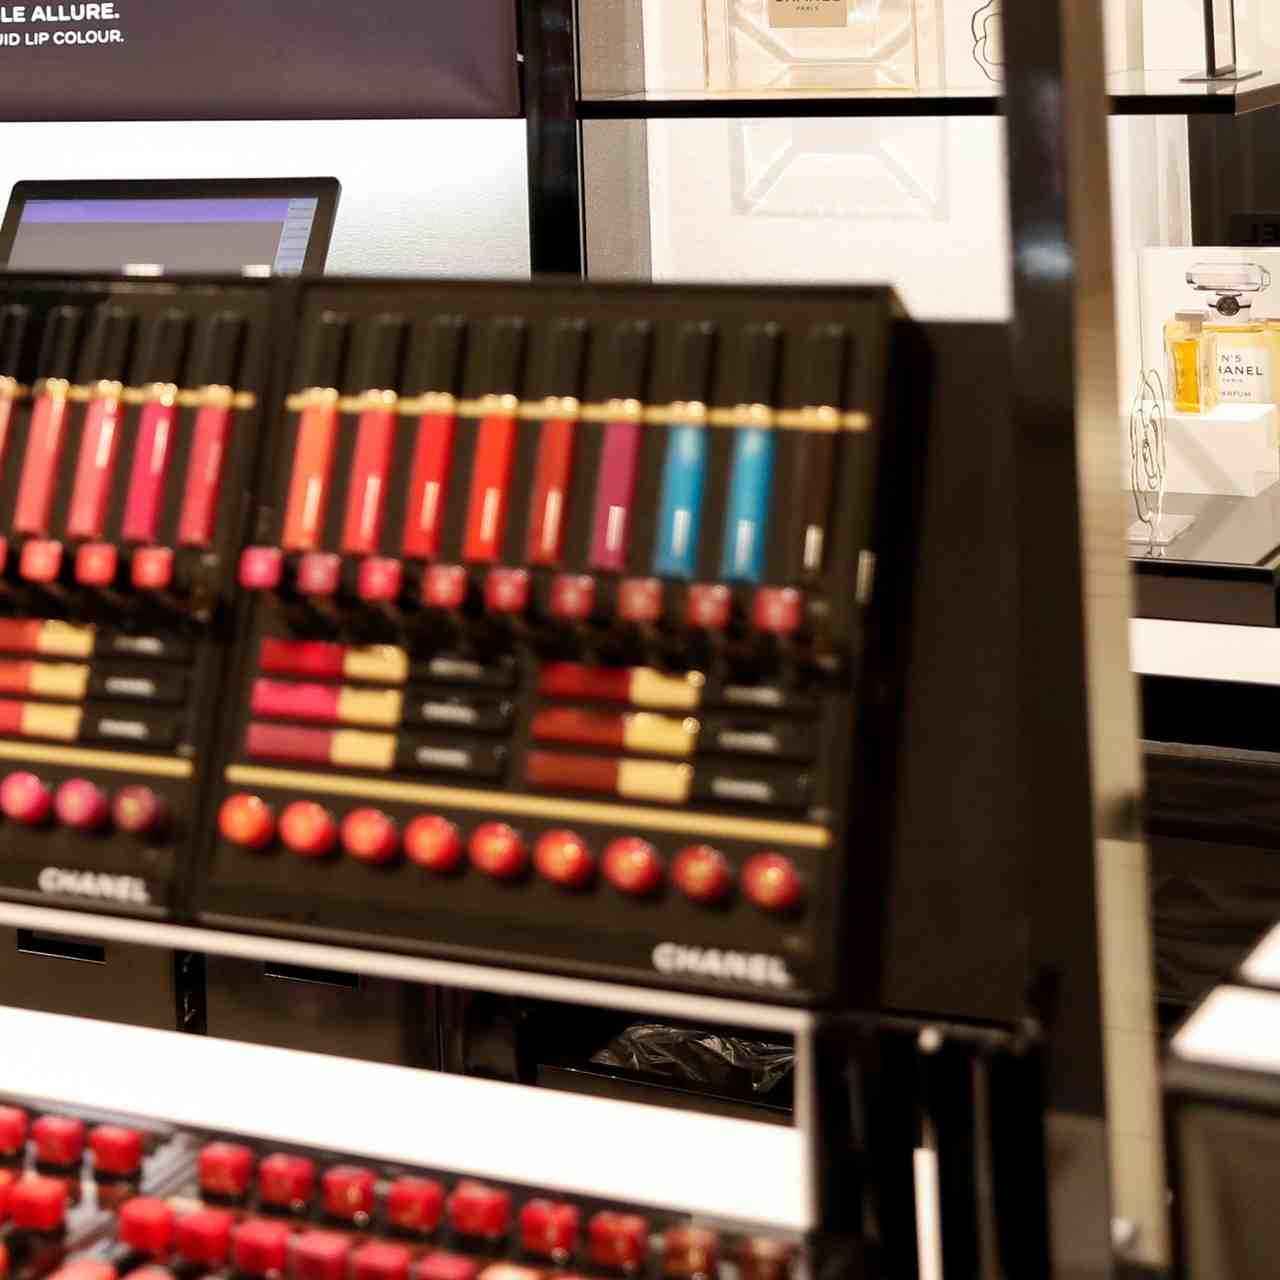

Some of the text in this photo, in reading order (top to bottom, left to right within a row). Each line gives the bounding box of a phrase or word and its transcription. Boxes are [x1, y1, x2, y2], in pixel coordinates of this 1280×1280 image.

[31, 2, 121, 22] ALLURE.
[25, 32, 50, 46] LIP
[52, 29, 125, 45] COLOUR.
[38, 866, 150, 902] CHANEL
[652, 942, 793, 987] CHANEL
